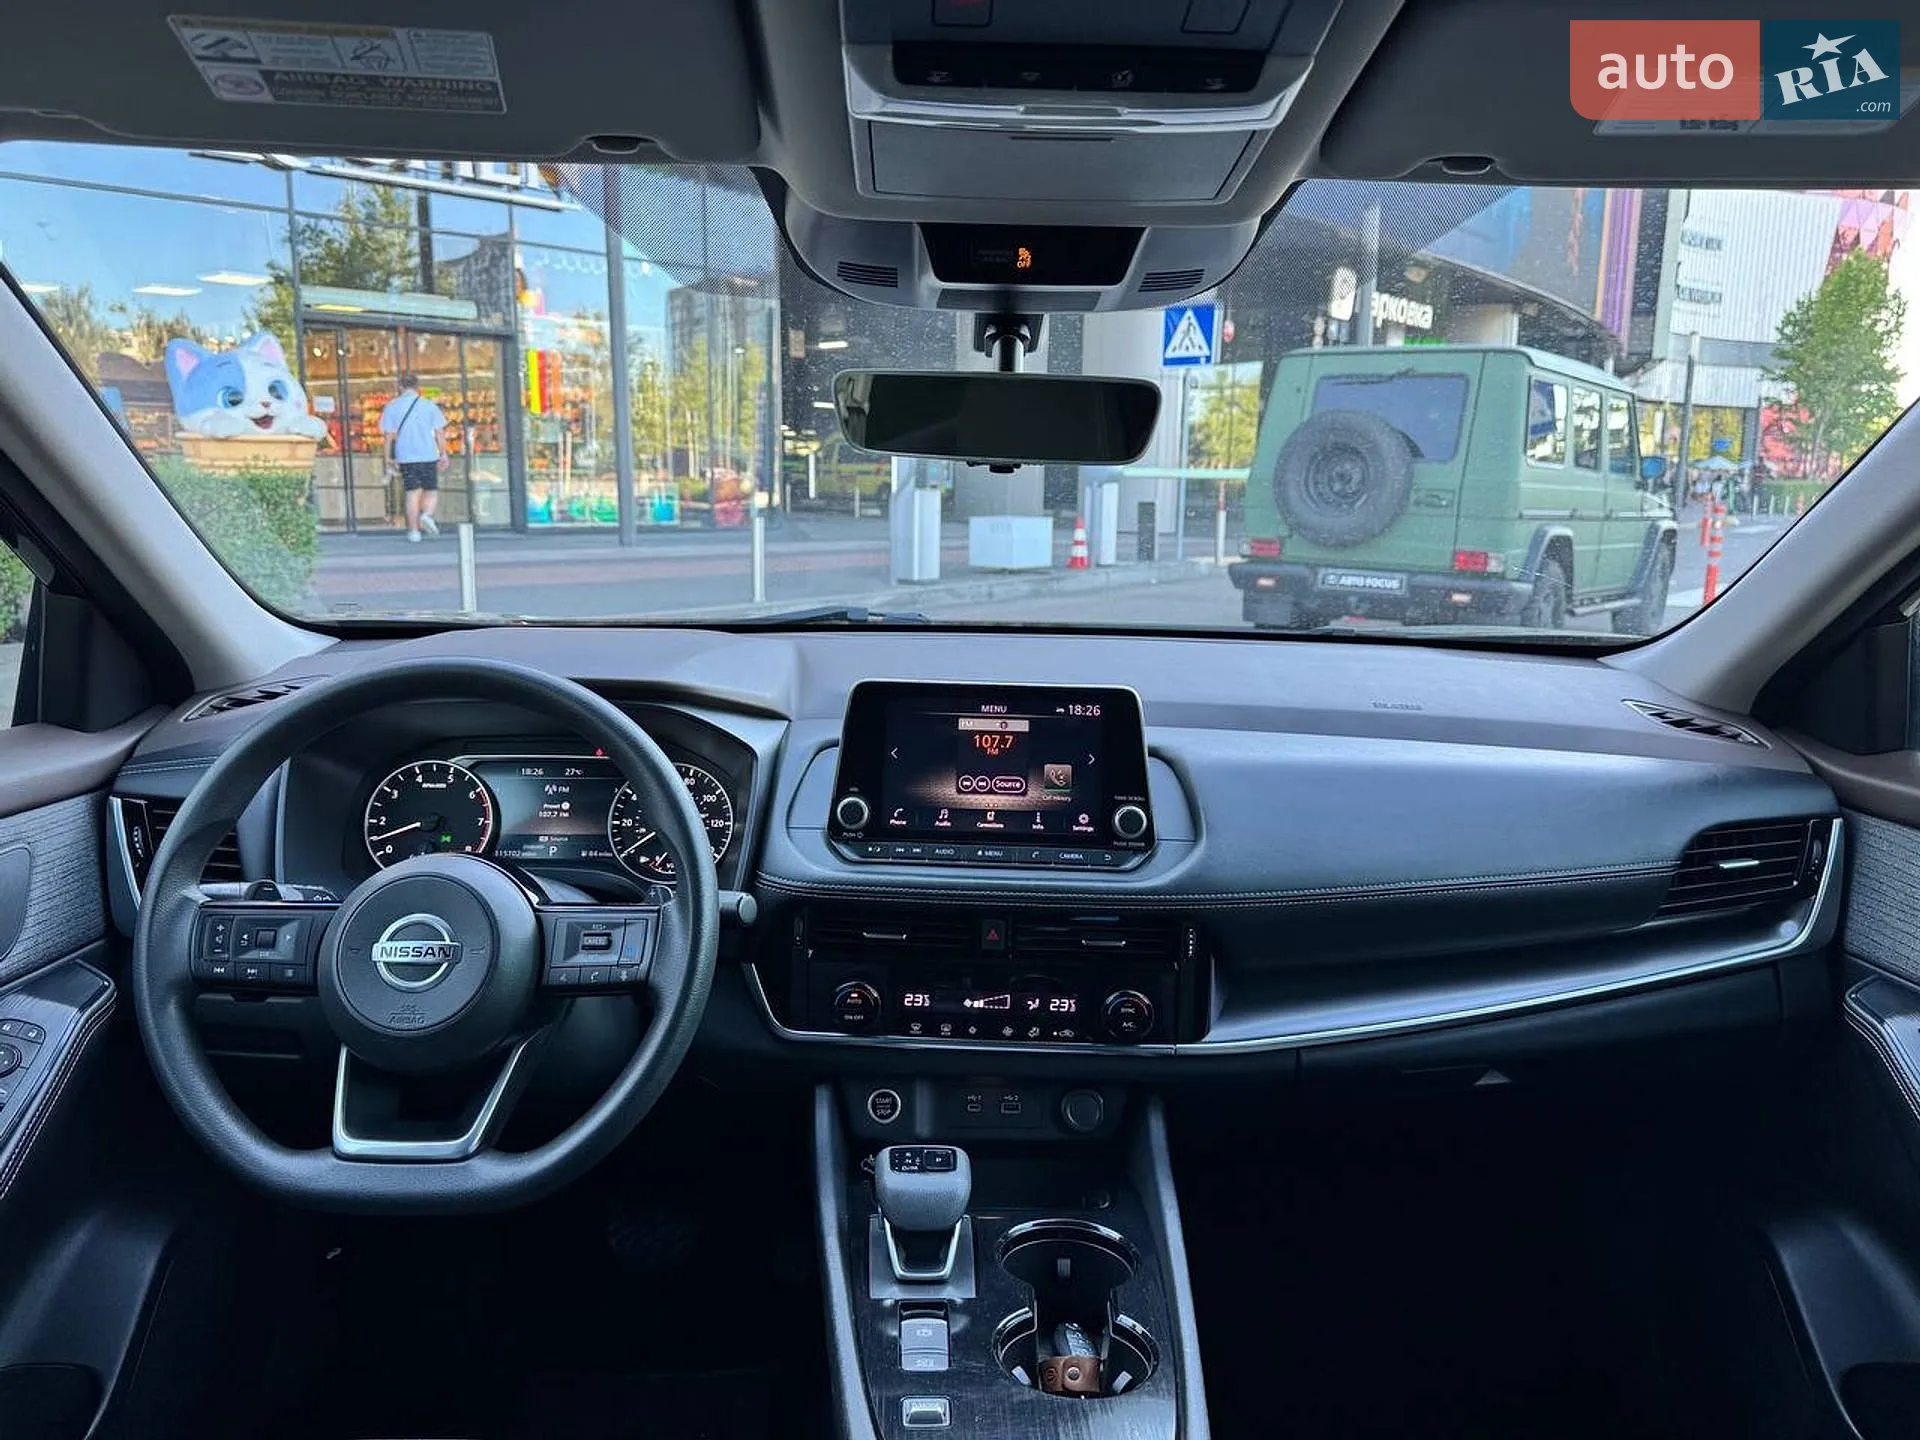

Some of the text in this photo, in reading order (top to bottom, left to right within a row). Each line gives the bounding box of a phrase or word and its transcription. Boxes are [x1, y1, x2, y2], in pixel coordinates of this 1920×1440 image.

[273, 71, 493, 92] AIRBAG WARNING
[1371, 291, 1433, 329] арковка
[981, 704, 1007, 713] MENU
[1068, 704, 1101, 716] 18:26
[974, 734, 1014, 748] 107.7
[415, 774, 423, 783] 4
[447, 774, 455, 783] 5
[995, 778, 1021, 788] Source
[391, 790, 399, 799] 3
[469, 792, 476, 800] 6
[380, 816, 387, 825] 2
[477, 817, 485, 826] 7
[621, 818, 633, 828] 20
[710, 818, 725, 828] 120
[385, 843, 393, 853] 0
[549, 846, 558, 857] P
[935, 848, 955, 856] AUDIO
[380, 946, 453, 958] NISSAN
